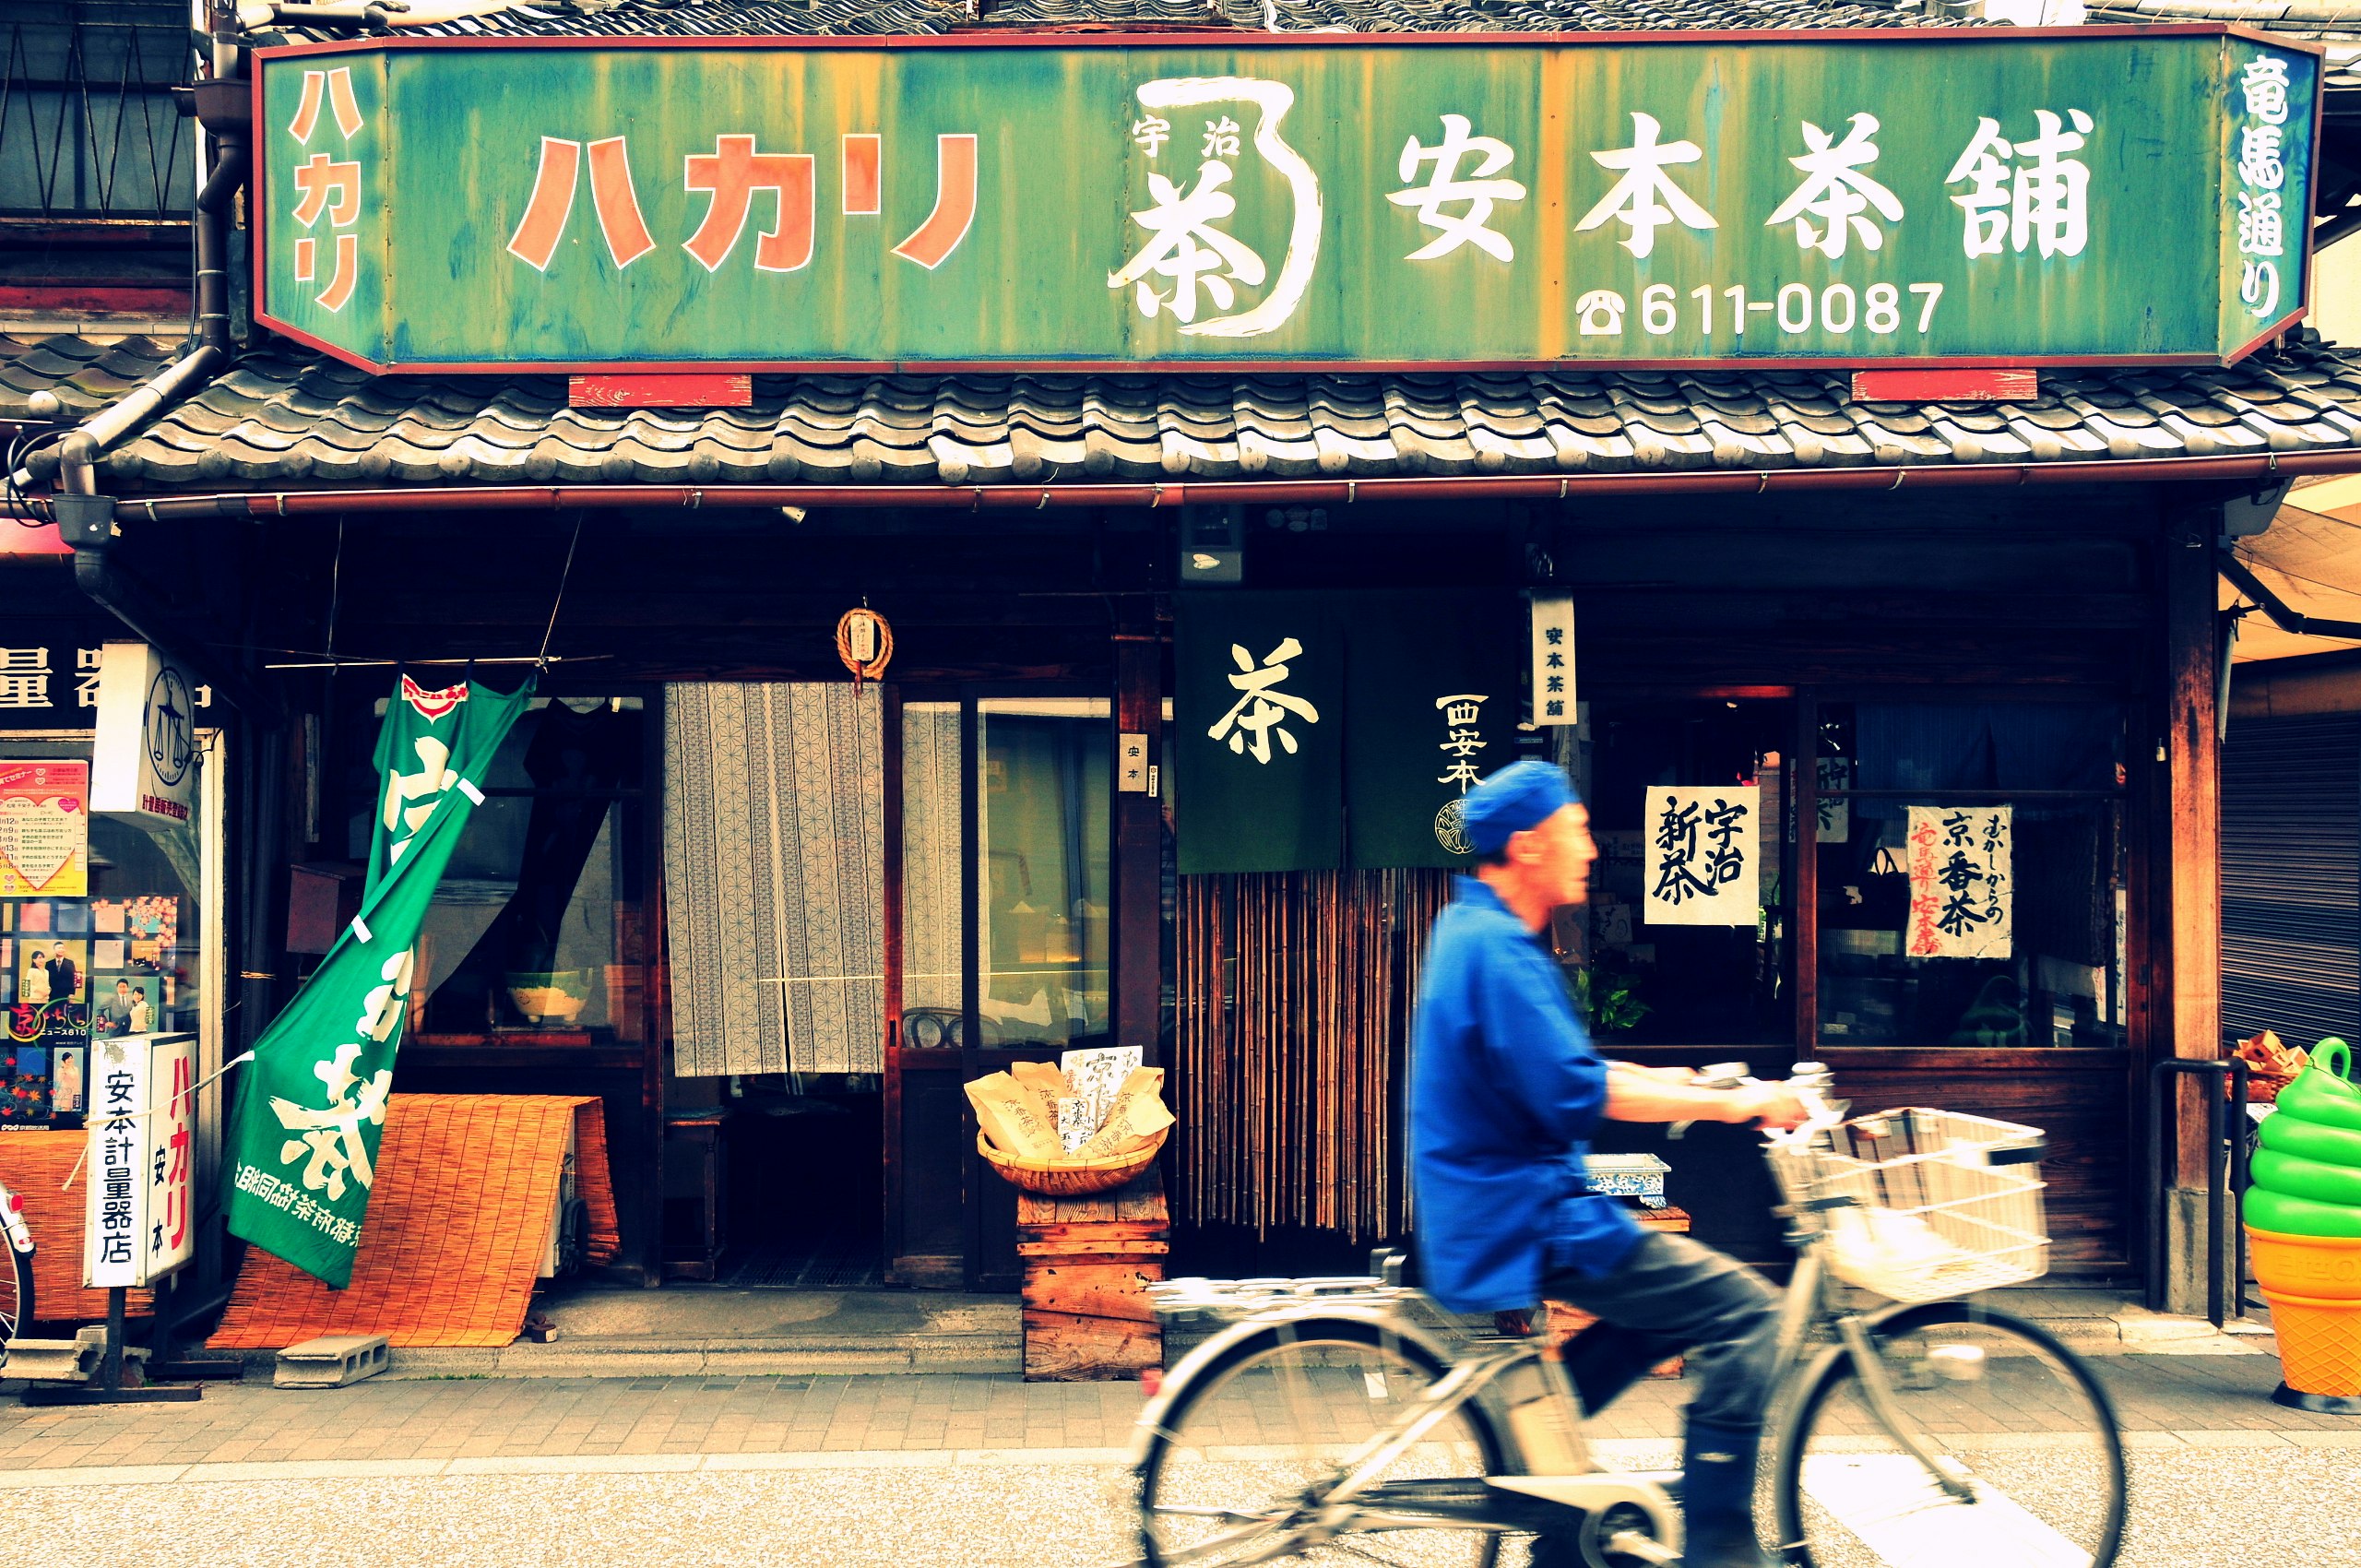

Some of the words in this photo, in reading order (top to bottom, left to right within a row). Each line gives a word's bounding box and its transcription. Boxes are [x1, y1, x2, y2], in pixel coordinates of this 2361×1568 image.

[288, 66, 363, 313] ハカリ
[1133, 114, 1240, 158] 宇治
[1384, 108, 2094, 263] 安本茶舗
[2238, 54, 2289, 317] 竜馬通り
[506, 134, 978, 273] ハカリ
[1107, 160, 1266, 323] 茶
[1641, 282, 1944, 335] 611-0087
[1207, 637, 1319, 765] 茶
[1546, 627, 1564, 716] 安本茶舗
[1128, 746, 1140, 780] 安本
[1653, 796, 1719, 905] 新茶
[1705, 799, 1748, 884] 宇治
[1937, 812, 1987, 937] 京番茶
[1983, 814, 2007, 924] むかしからの
[101, 1070, 136, 1264] 安本計量器店
[151, 1144, 166, 1258] 安本
[167, 1056, 191, 1250] ハカリ
